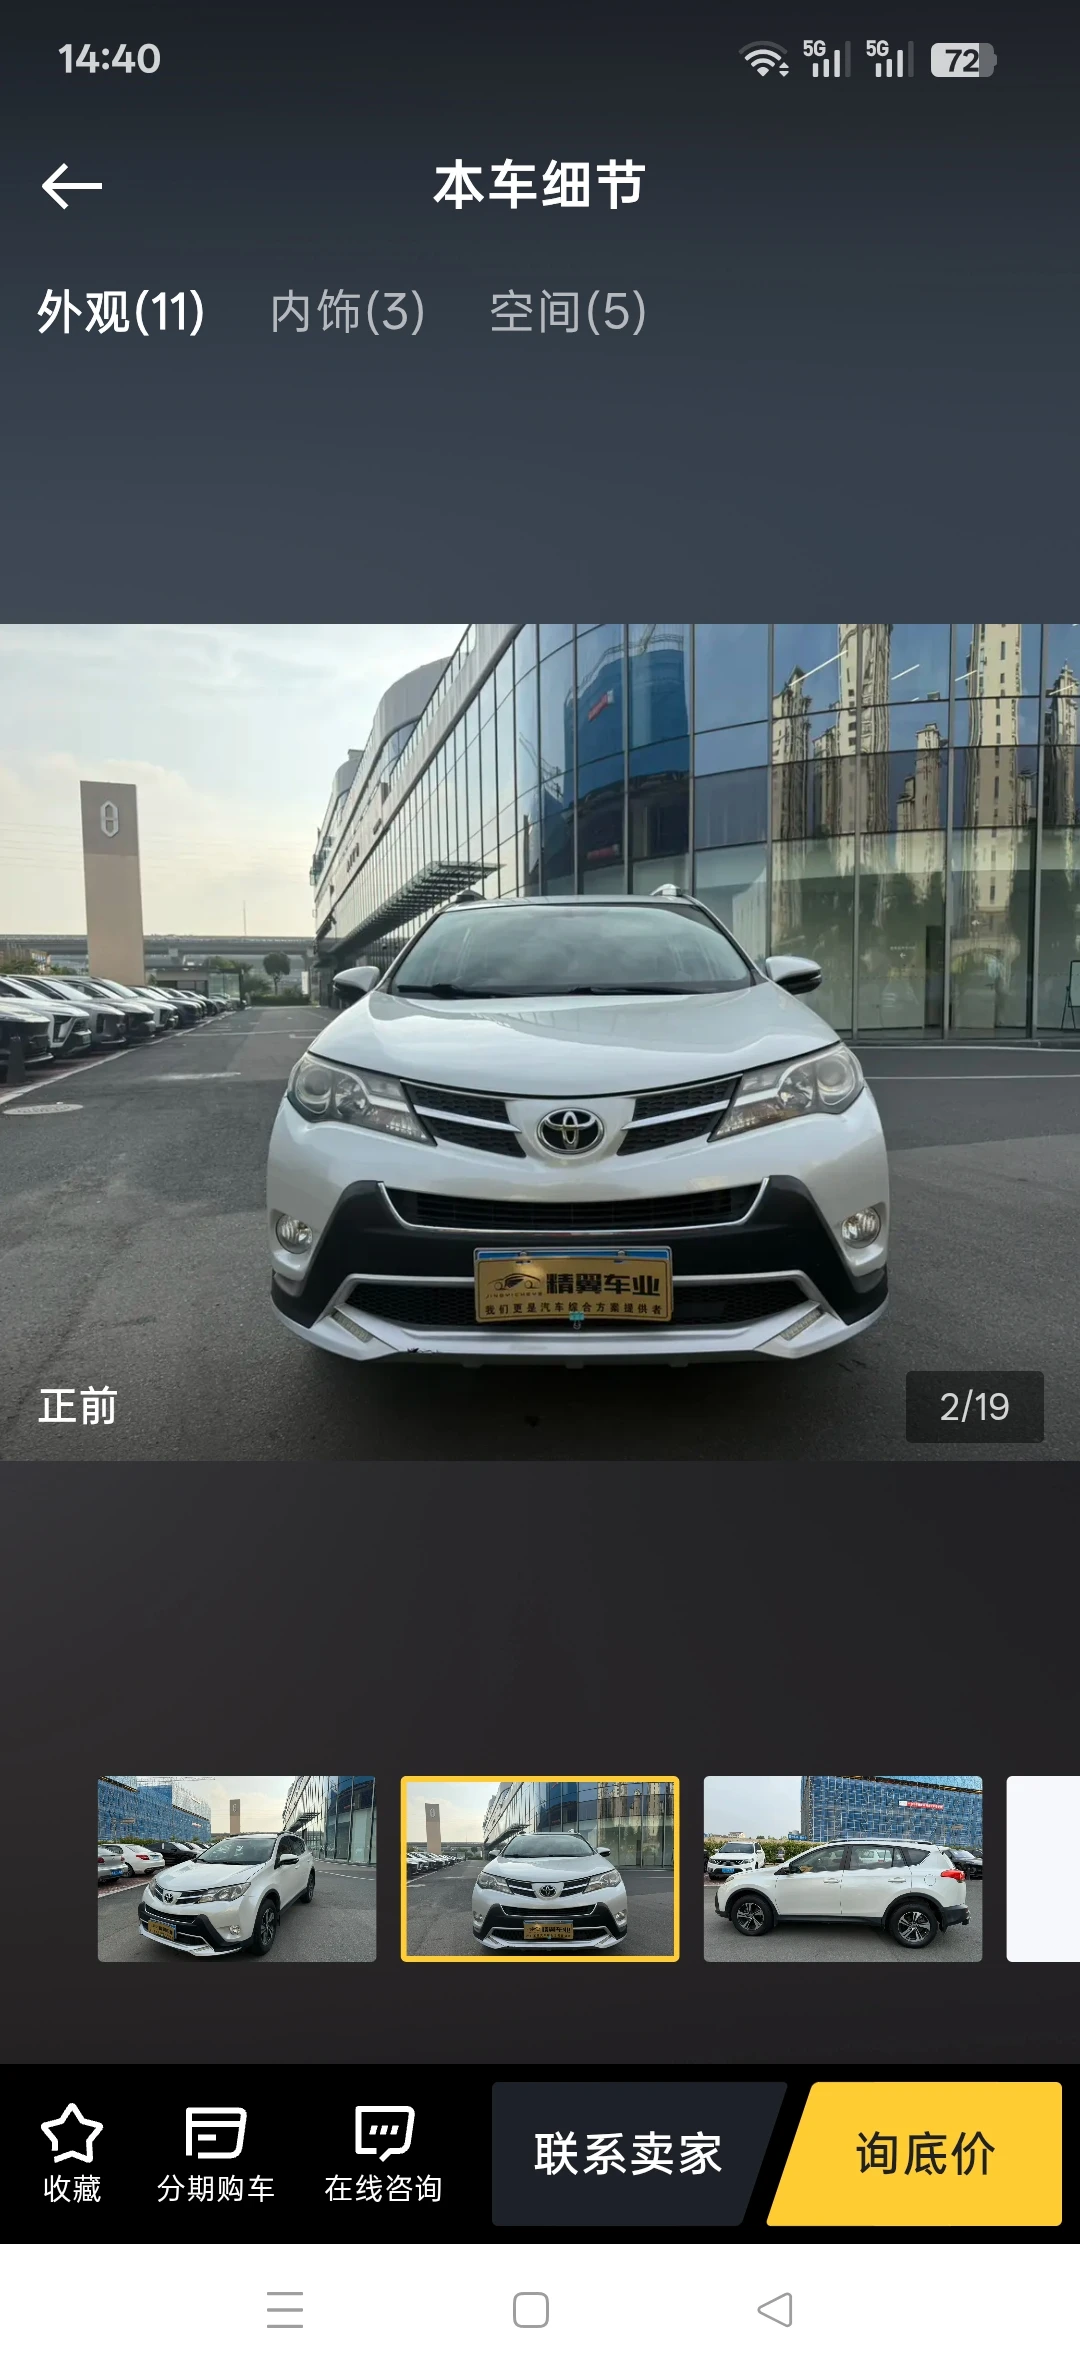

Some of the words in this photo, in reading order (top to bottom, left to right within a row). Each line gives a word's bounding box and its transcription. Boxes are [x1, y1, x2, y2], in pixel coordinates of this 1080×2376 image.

[58, 43, 161, 74] 14:40
[803, 40, 826, 57] 5G
[866, 40, 889, 57] 5G
[945, 49, 980, 72] 72
[433, 158, 646, 209] 本车细节
[37, 289, 204, 336] 外观(11)
[271, 289, 424, 336] 内饰(3)
[490, 289, 645, 336] 空间(5)
[546, 1273, 661, 1297] 精翼车业
[485, 1301, 663, 1315] 我们更是汽车综合方案提供者
[533, 2131, 723, 2176] 联系卖家
[855, 2131, 996, 2176] 询底价
[43, 2174, 102, 2203] 收藏
[157, 2174, 275, 2203] 分期购车
[324, 2174, 442, 2203] 在线咨询
